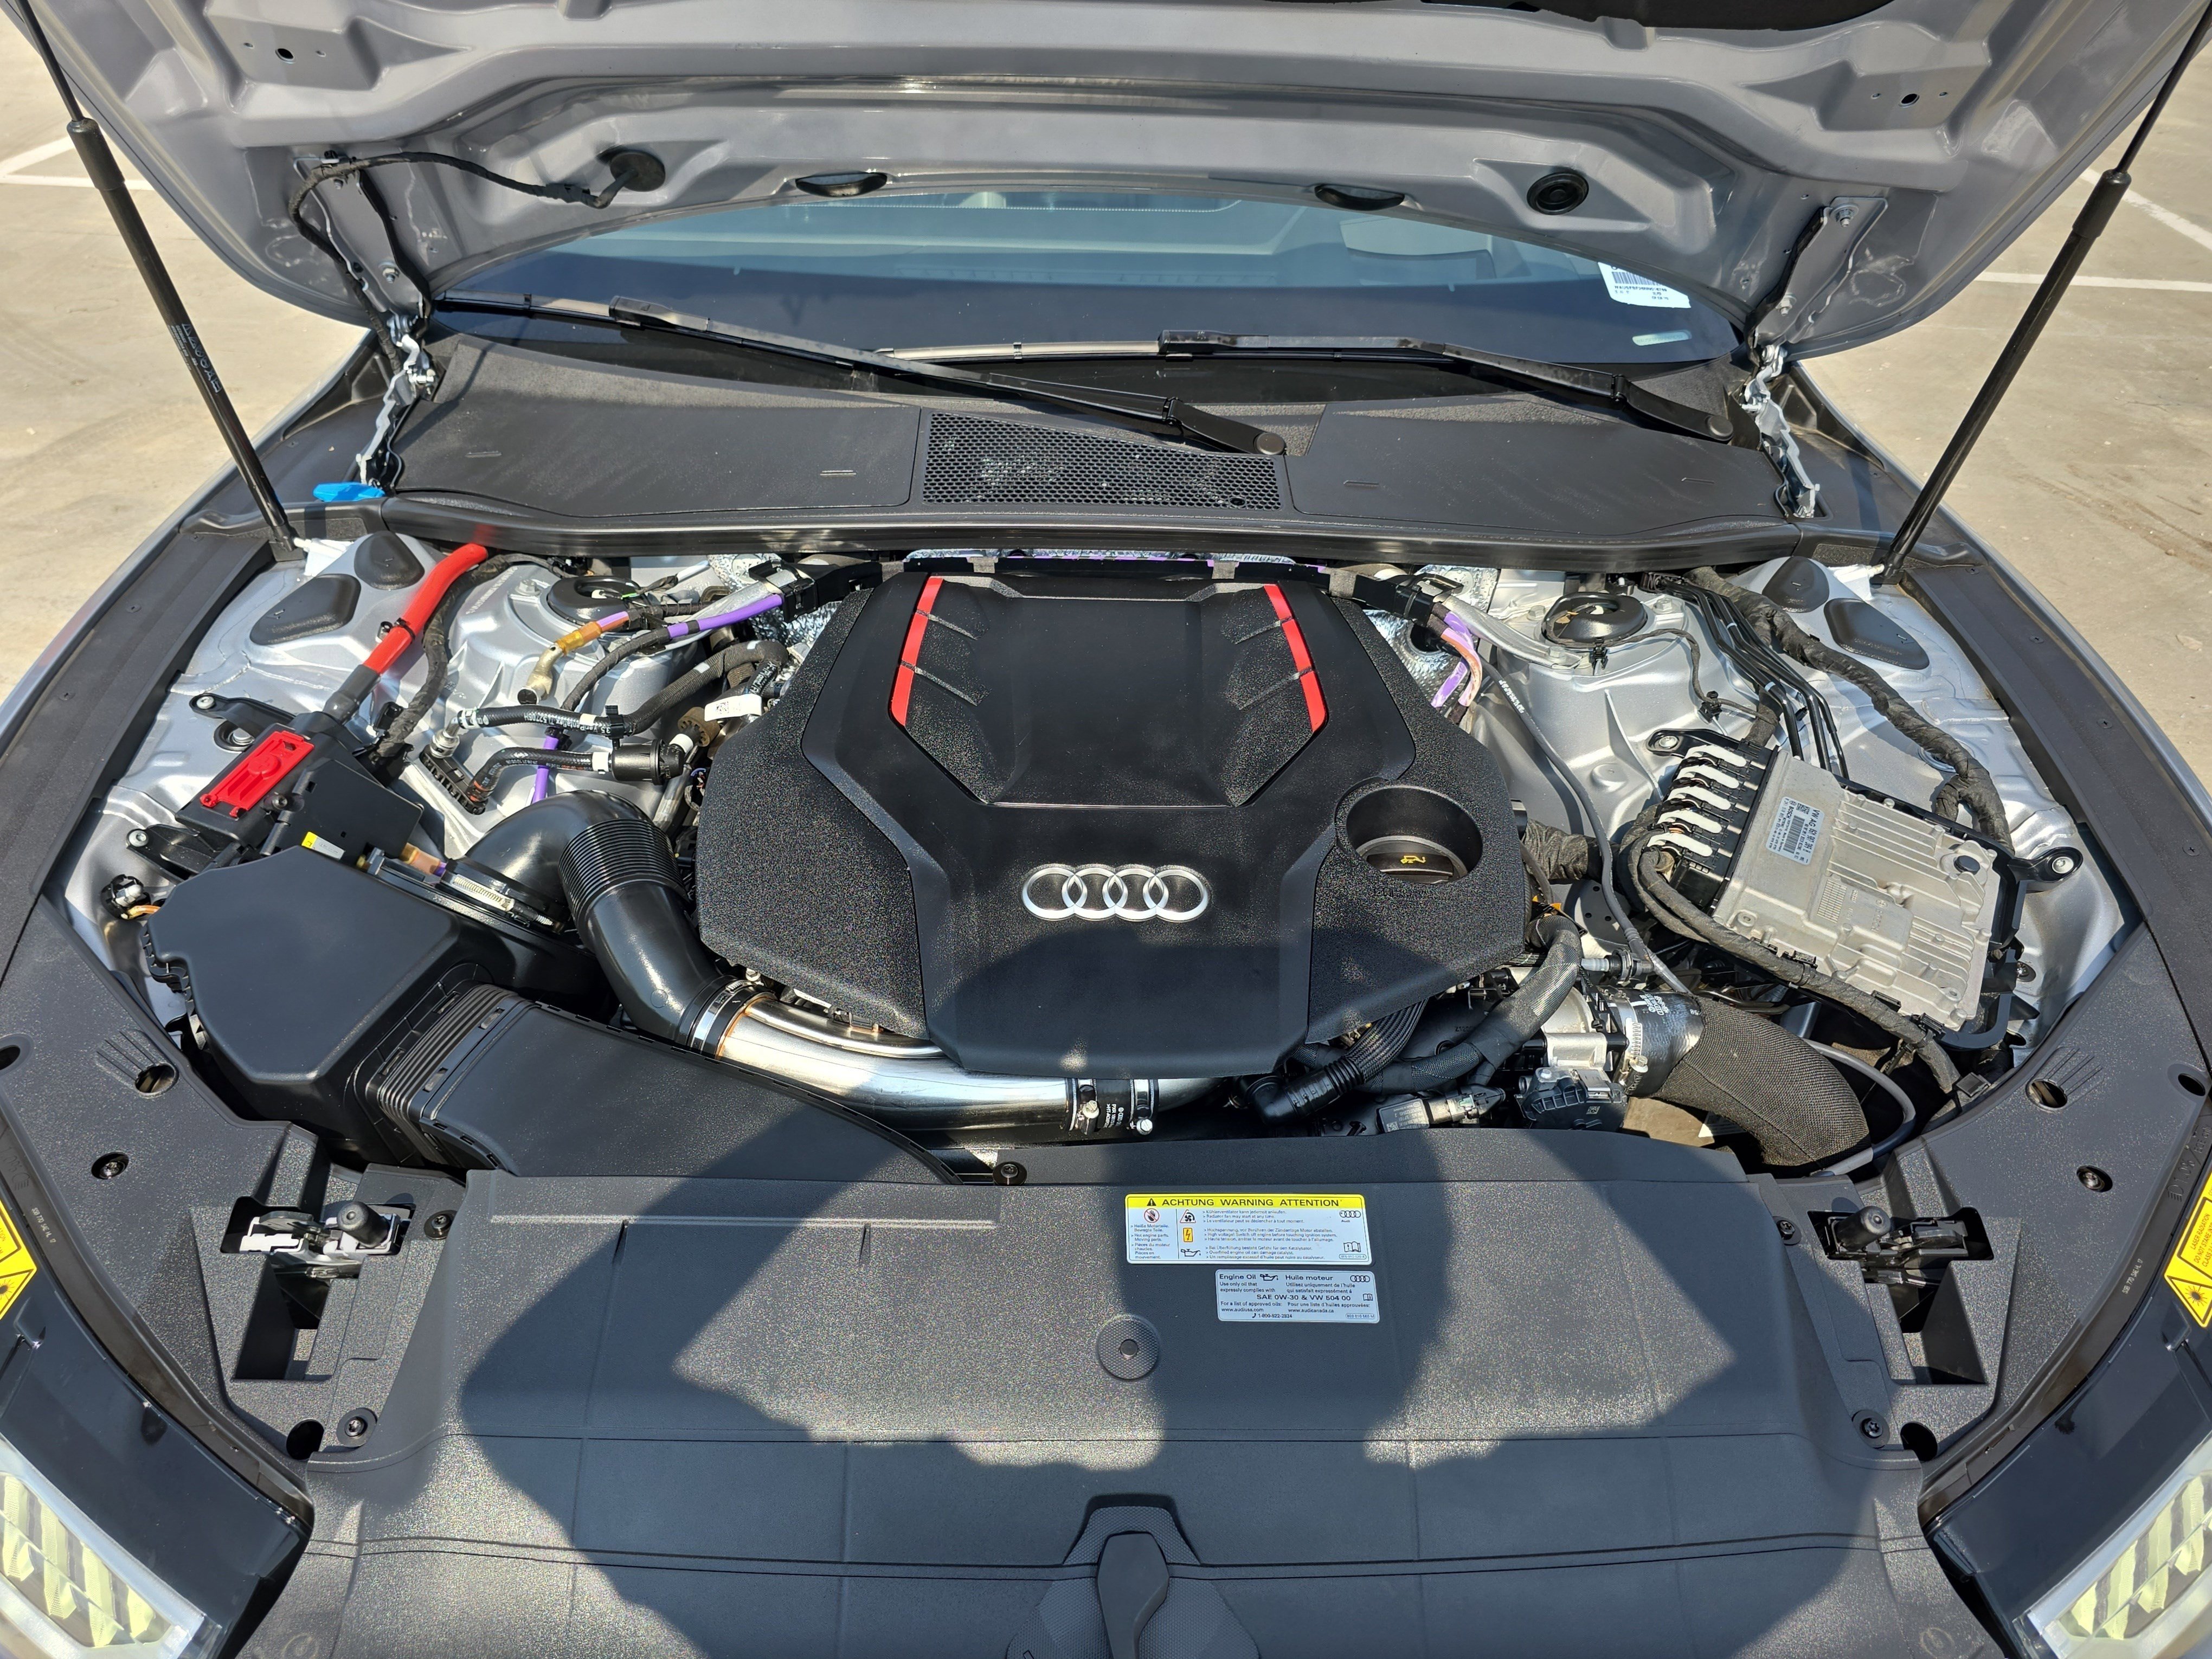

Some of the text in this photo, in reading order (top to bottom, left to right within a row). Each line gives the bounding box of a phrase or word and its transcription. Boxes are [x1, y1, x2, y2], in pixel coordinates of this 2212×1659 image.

[1812, 809, 1821, 819] VW
[1809, 818, 1818, 827] AG
[1162, 1198, 1339, 1207] ACHTUNG WARNING ATTENTION
[2190, 1213, 2210, 1250] LASER RADIATION
[2194, 1255, 2201, 1264] DO
[2201, 1232, 2209, 1248] STARE
[2202, 1250, 2212, 1267] CLASS
[2130, 1269, 2139, 1278] SAE
